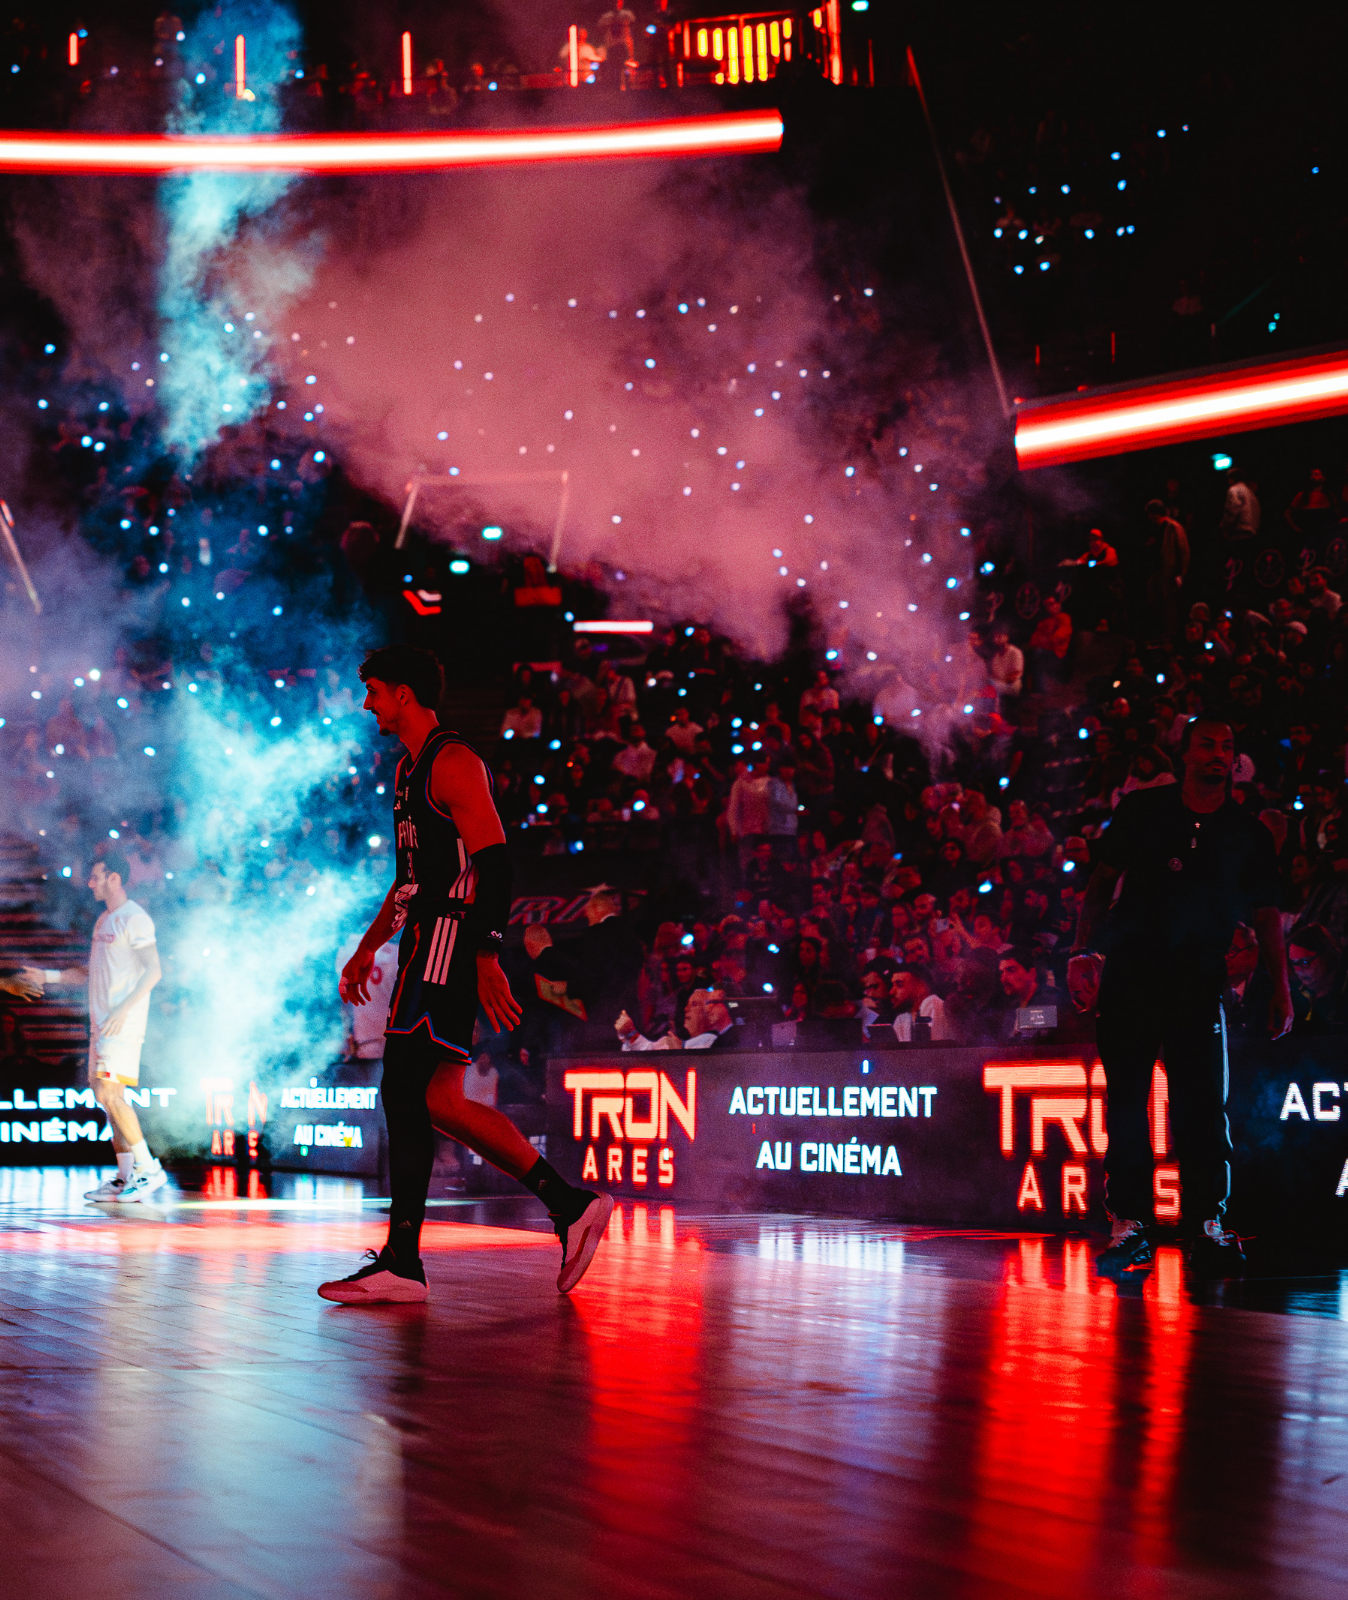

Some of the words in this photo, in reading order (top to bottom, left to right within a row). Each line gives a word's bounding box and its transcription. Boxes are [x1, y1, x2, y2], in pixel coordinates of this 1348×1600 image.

[0, 1087, 178, 1110] LEMNT
[200, 1077, 268, 1126] TRN
[564, 1067, 697, 1141] TRON
[728, 1086, 938, 1118] ACTUELLEMENT
[1279, 1082, 1348, 1121] AC
[211, 1129, 260, 1159] ARS
[293, 1123, 314, 1146] AU
[583, 1144, 675, 1187] ARES
[756, 1141, 792, 1170] AU
[800, 1136, 903, 1176] CINÉMA
[1016, 1161, 1181, 1220] ARS
